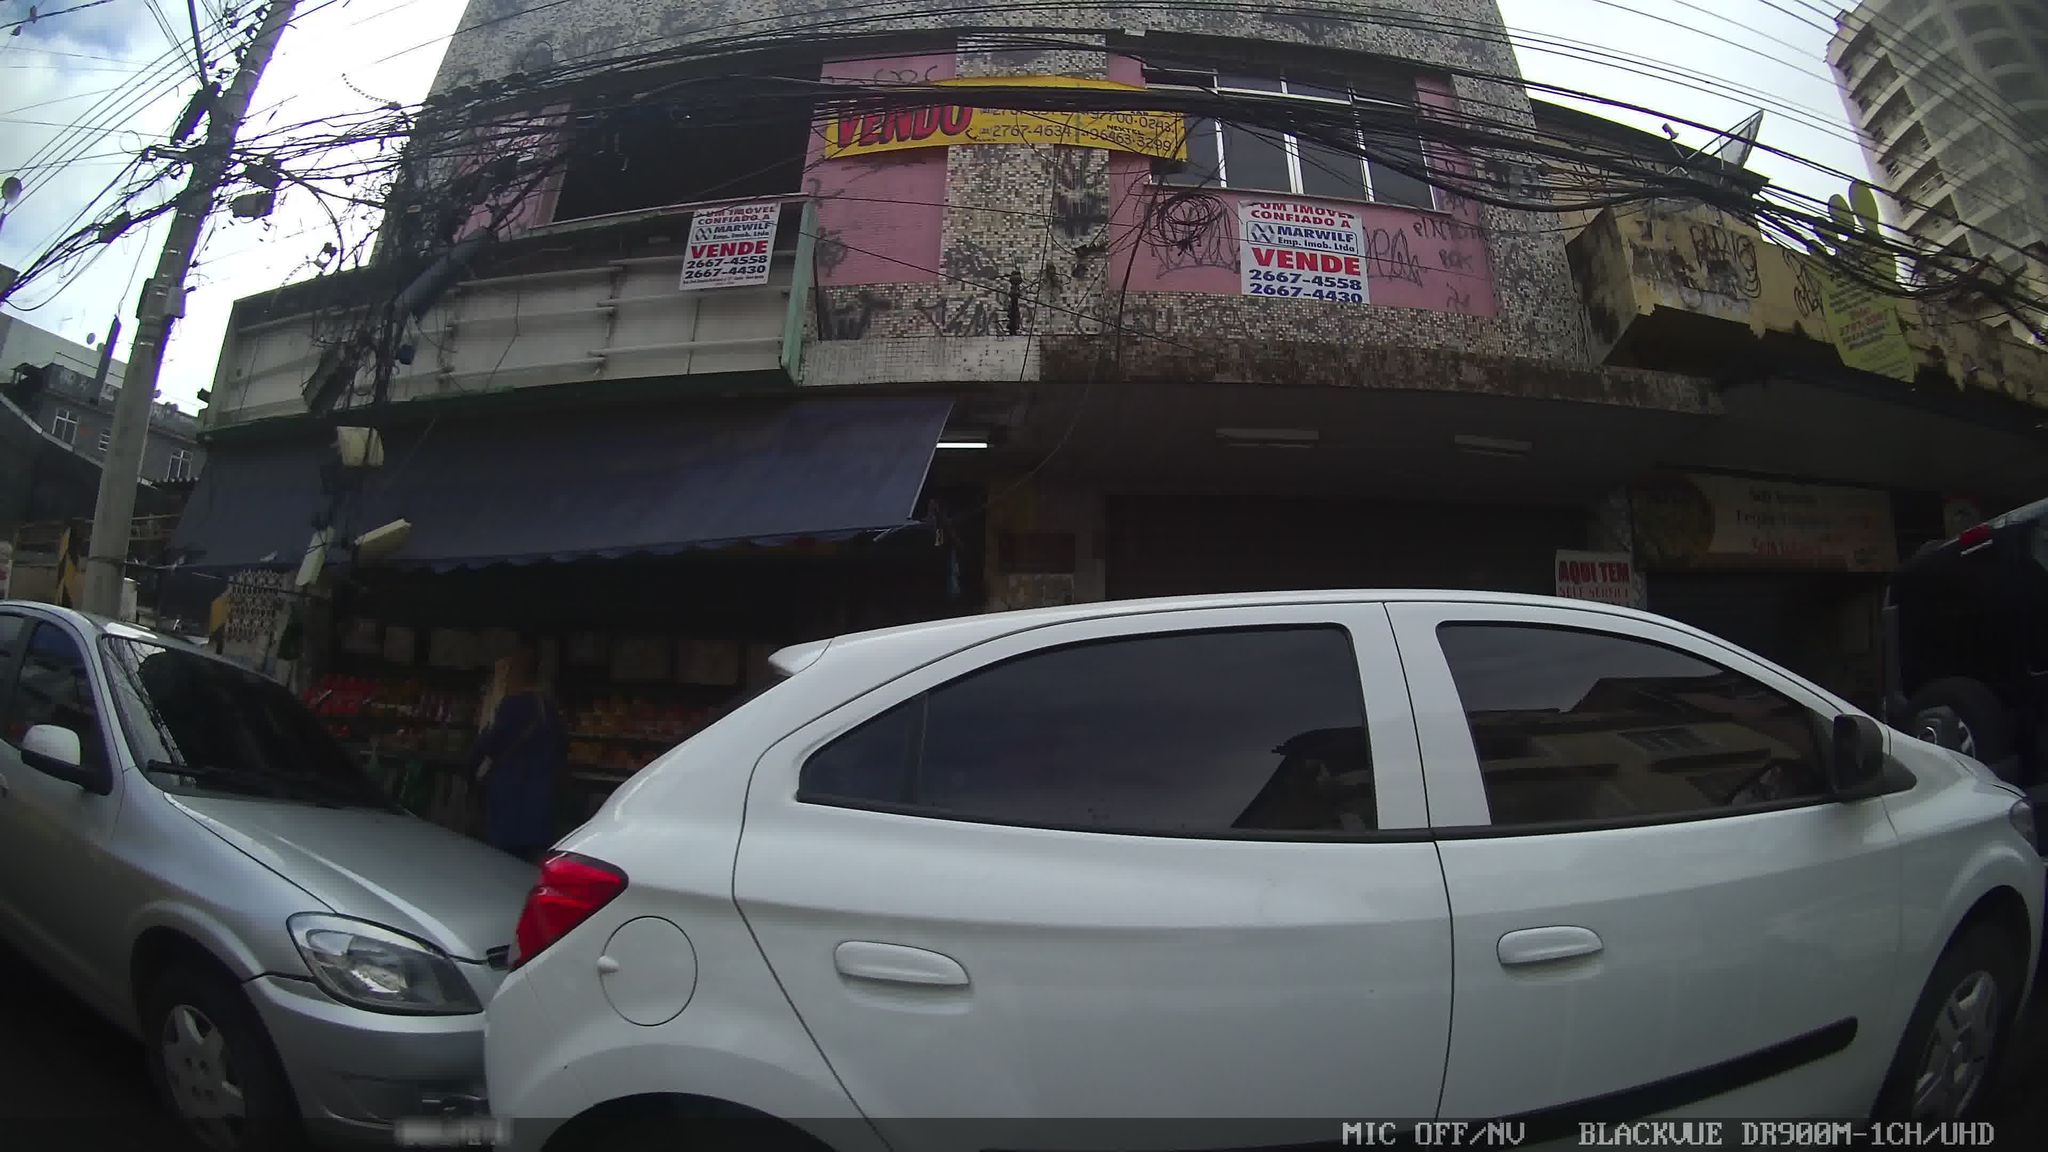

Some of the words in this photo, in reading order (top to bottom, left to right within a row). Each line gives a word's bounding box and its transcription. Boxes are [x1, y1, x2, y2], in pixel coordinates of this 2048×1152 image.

[838, 105, 973, 149] VENDO
[697, 214, 758, 225] CONFIADO
[762, 213, 770, 221] A
[1251, 210, 1335, 227] CONFIADO
[1341, 220, 1352, 229] A
[1277, 226, 1354, 243] MARWILF
[690, 240, 769, 259] VENDE
[1278, 237, 1302, 247] Emp.
[1304, 240, 1332, 250] Imob.
[1334, 243, 1356, 253] Ltda
[686, 254, 768, 269] 2667-4558
[1251, 247, 1361, 276] VENDE
[685, 264, 766, 280] 2667-4430
[1249, 269, 1362, 291] 2667-4558
[1249, 282, 1363, 304] 2667-4430
[1559, 560, 1597, 585] AQUI
[1598, 561, 1630, 584] TEM
